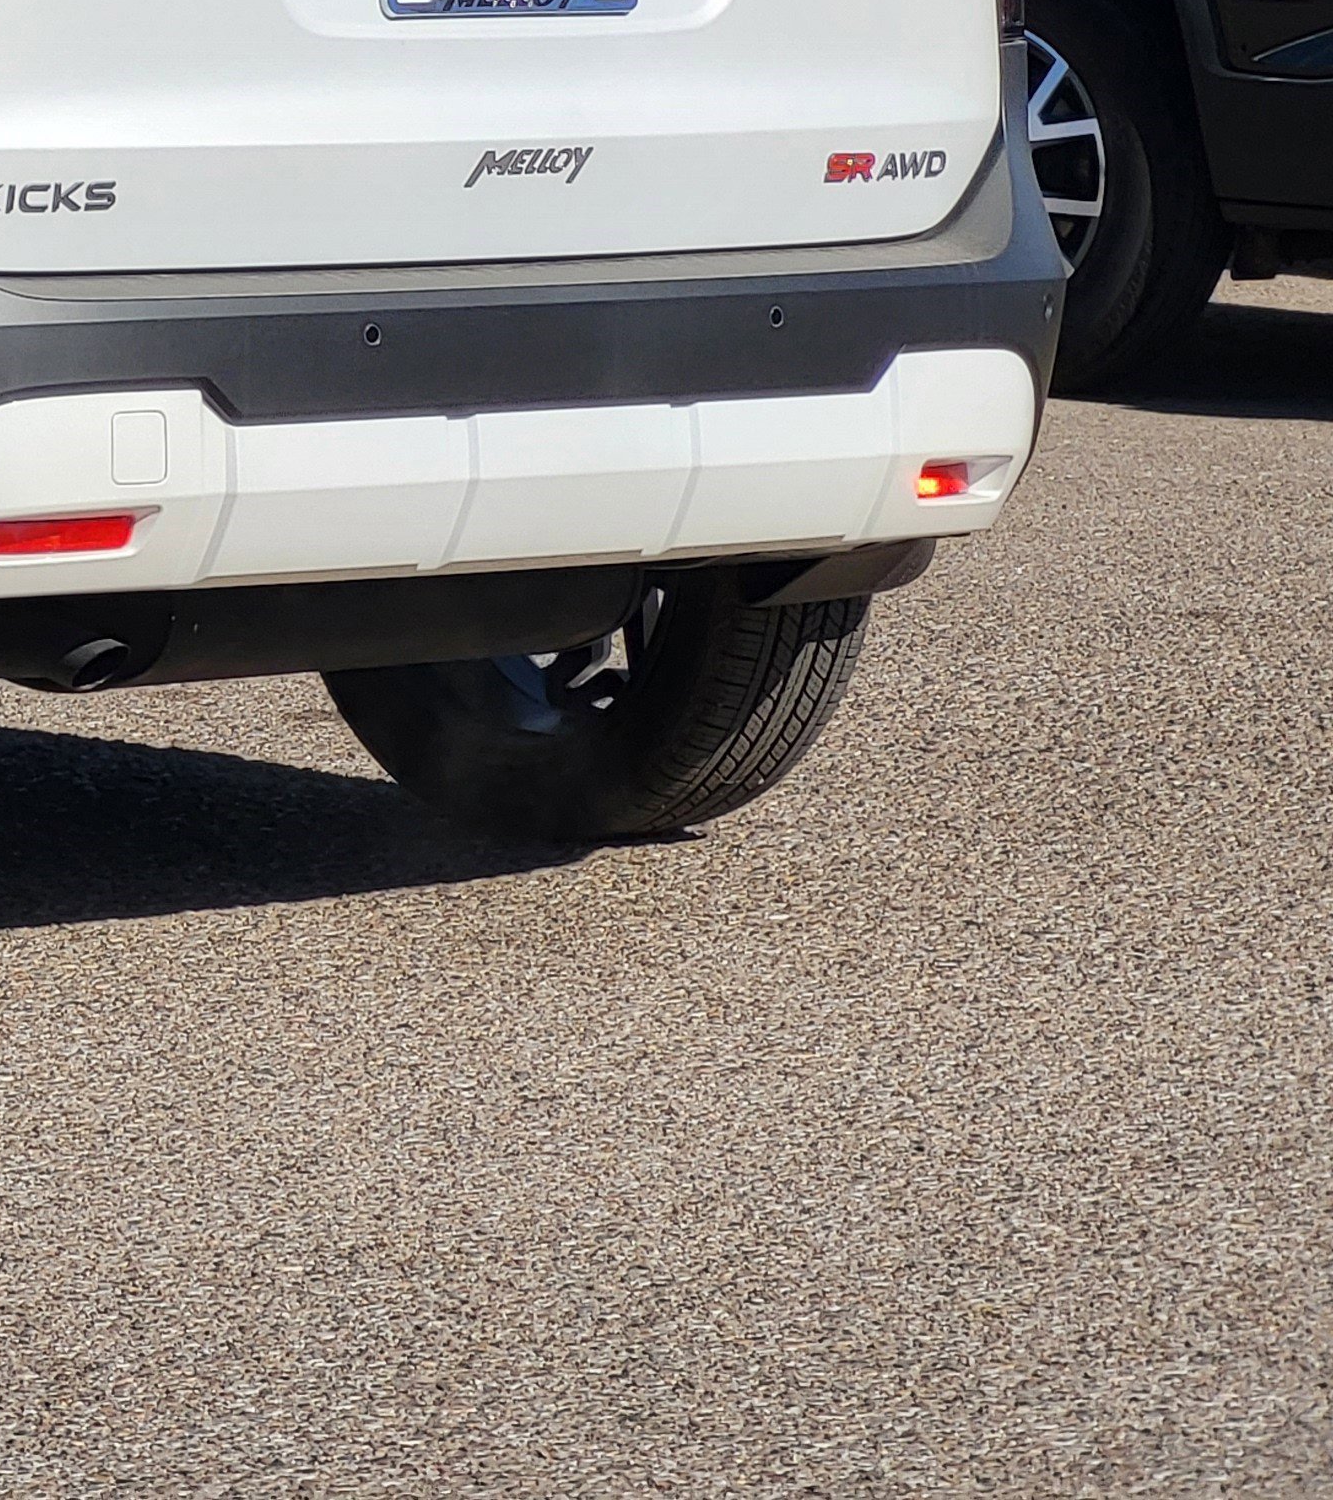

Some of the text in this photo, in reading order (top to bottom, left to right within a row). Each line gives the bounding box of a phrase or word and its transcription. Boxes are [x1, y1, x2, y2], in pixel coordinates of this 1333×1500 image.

[463, 147, 594, 188] MELLOY
[823, 150, 947, 183] SR AWD
